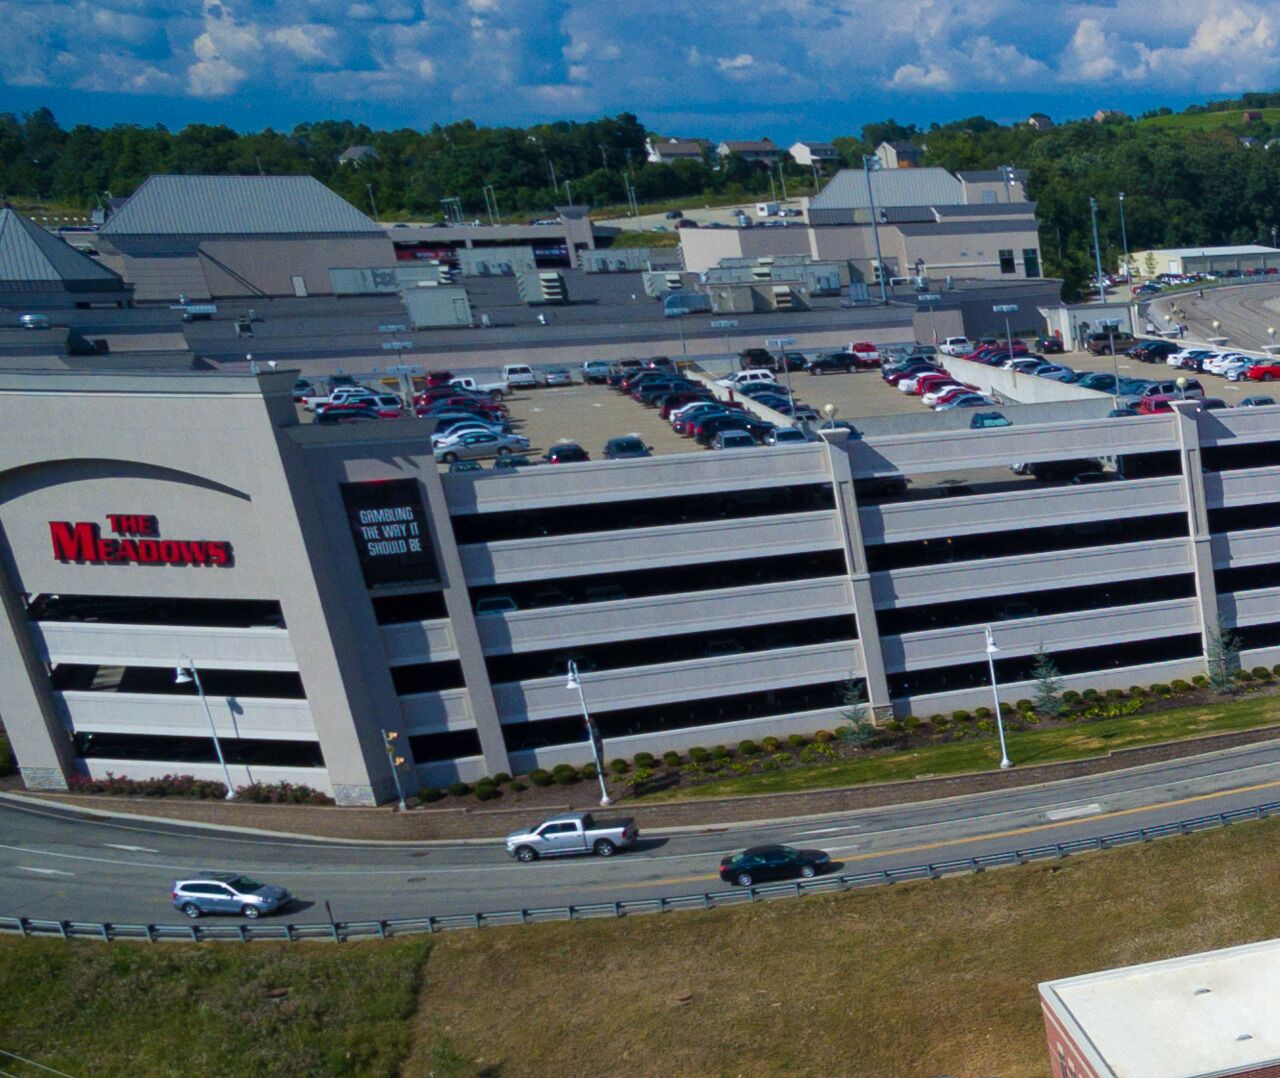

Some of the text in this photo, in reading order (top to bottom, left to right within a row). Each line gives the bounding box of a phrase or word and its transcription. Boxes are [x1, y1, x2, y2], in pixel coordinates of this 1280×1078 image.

[105, 514, 158, 536] THE
[360, 507, 414, 524] GAMBLING
[361, 522, 420, 541] THE WAY IT
[49, 521, 233, 566] MEADOWS
[368, 539, 423, 556] SHOULD BE
